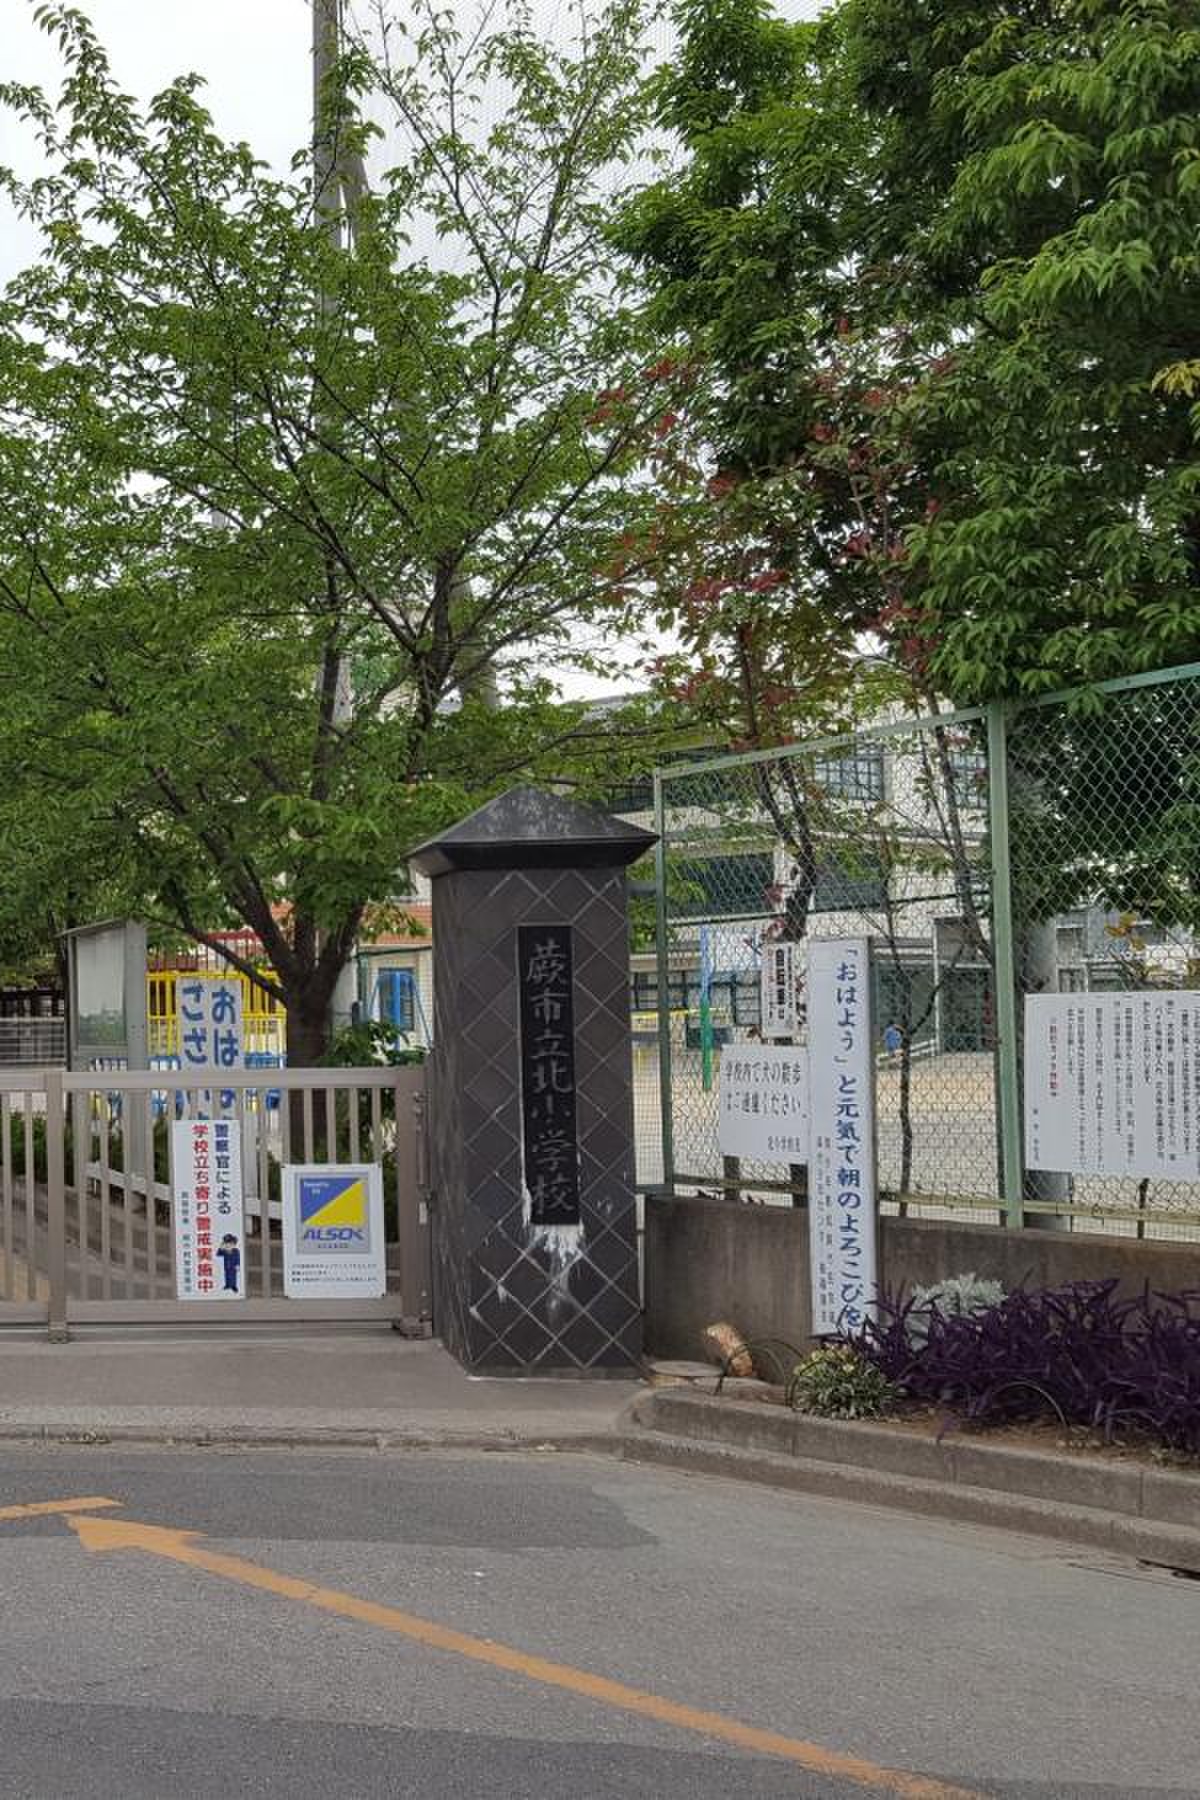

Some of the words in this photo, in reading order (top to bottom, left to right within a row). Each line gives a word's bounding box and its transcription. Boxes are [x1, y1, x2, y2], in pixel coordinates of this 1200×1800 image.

[526, 938, 574, 1216] 蕨市立北小学校
[303, 1227, 365, 1241] ALSOK
